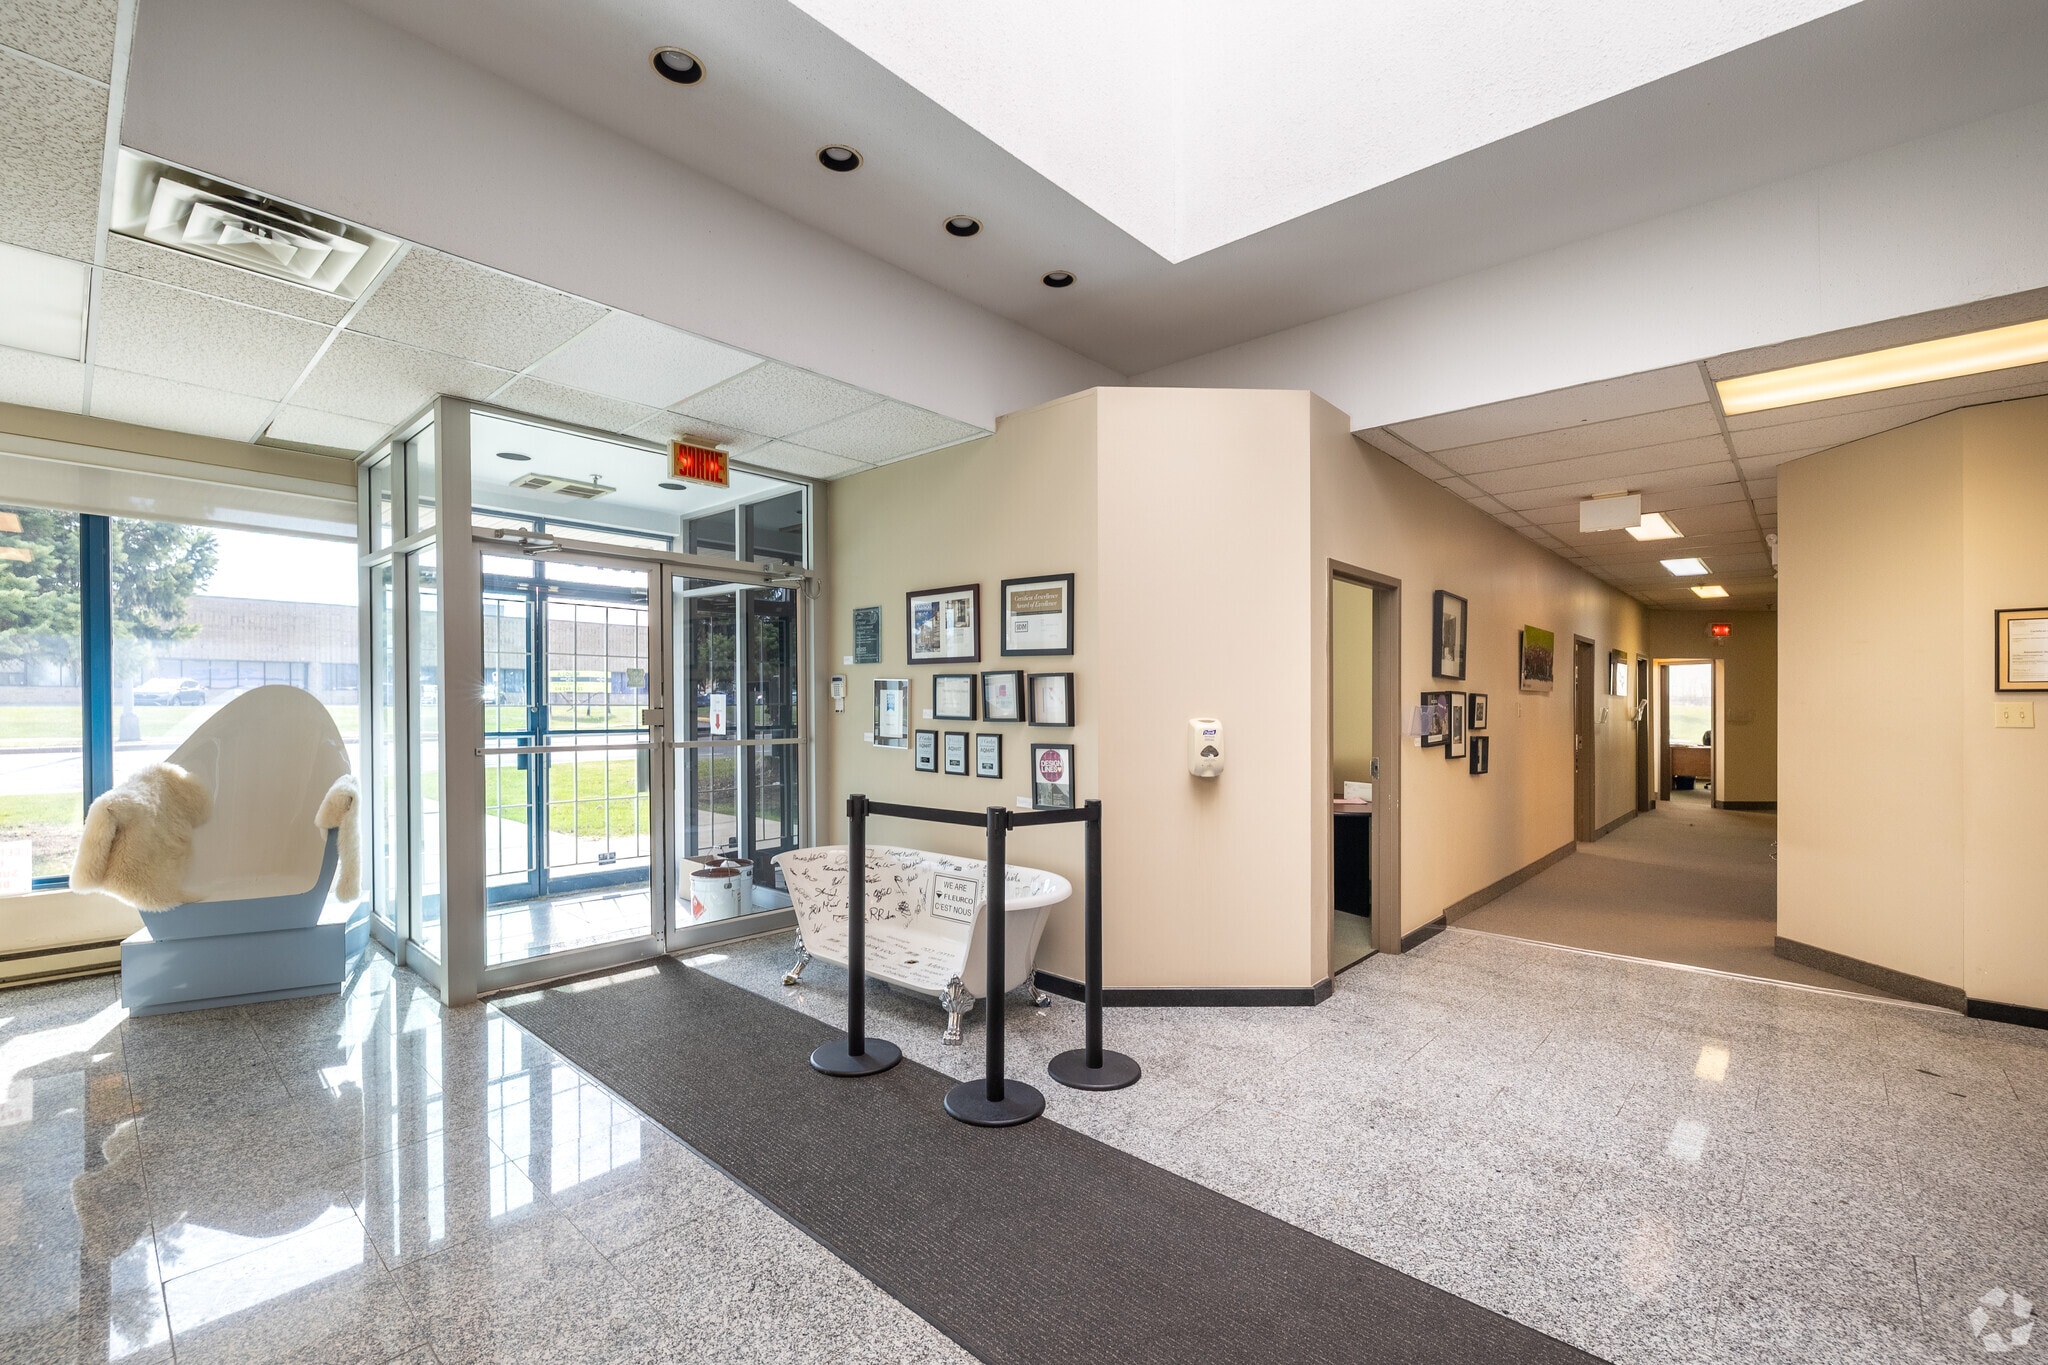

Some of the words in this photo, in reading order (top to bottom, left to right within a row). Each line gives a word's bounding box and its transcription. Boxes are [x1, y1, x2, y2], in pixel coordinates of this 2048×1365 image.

[679, 444, 724, 483] SORTIE
[1040, 759, 1063, 767] DESIGN
[943, 880, 954, 890] WE
[954, 883, 967, 892] ARE
[943, 894, 974, 905] FLEURCO
[934, 902, 952, 912] C'EST
[953, 905, 972, 917] NOUS
